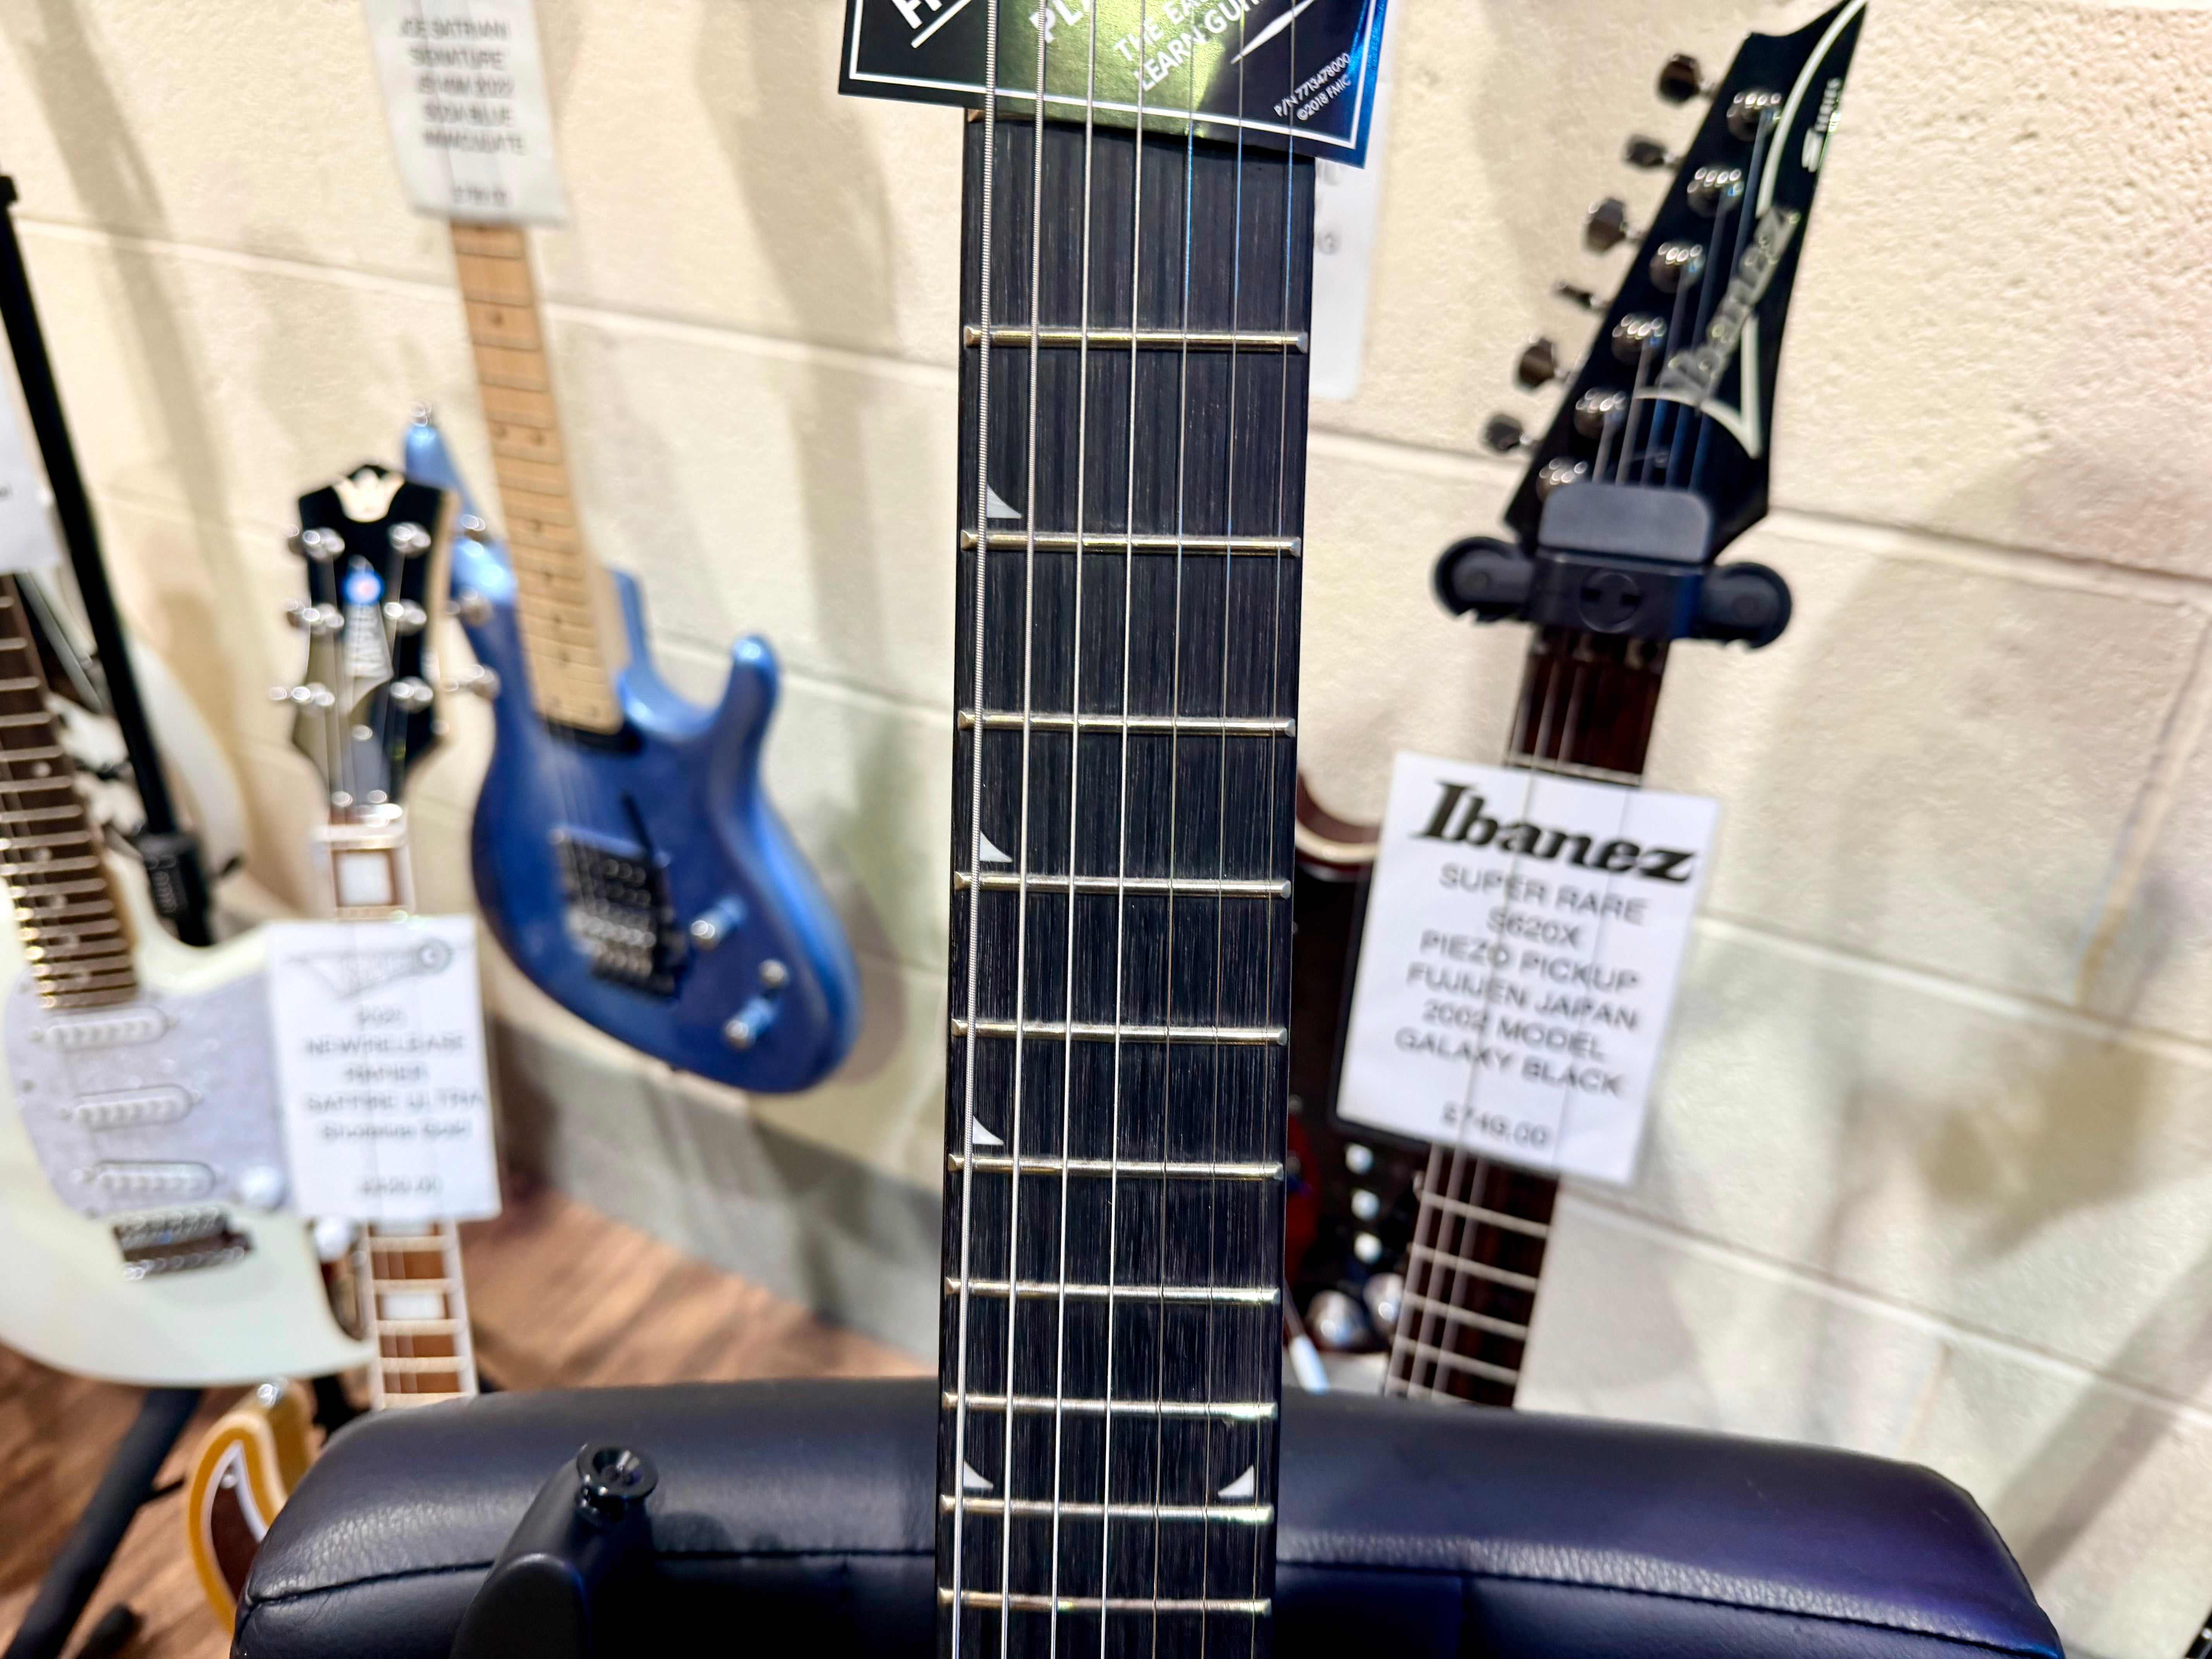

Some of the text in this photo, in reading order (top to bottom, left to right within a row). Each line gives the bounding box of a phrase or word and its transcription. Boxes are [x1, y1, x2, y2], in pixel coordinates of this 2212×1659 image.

[1113, 16, 1163, 62] THE
[1133, 25, 1207, 92] LEARN
[1274, 94, 1298, 117] P/N
[1326, 73, 1351, 98] FMIC
[1411, 781, 1695, 883] Ibanez
[1439, 862, 1649, 926] SUPER RARE
[1420, 929, 1641, 993] PIEZO PICKUP
[1534, 991, 1639, 1032] JAPAN
[1394, 1026, 1626, 1098] GALAXY BLACK
[1496, 1016, 1606, 1063] MODEL
